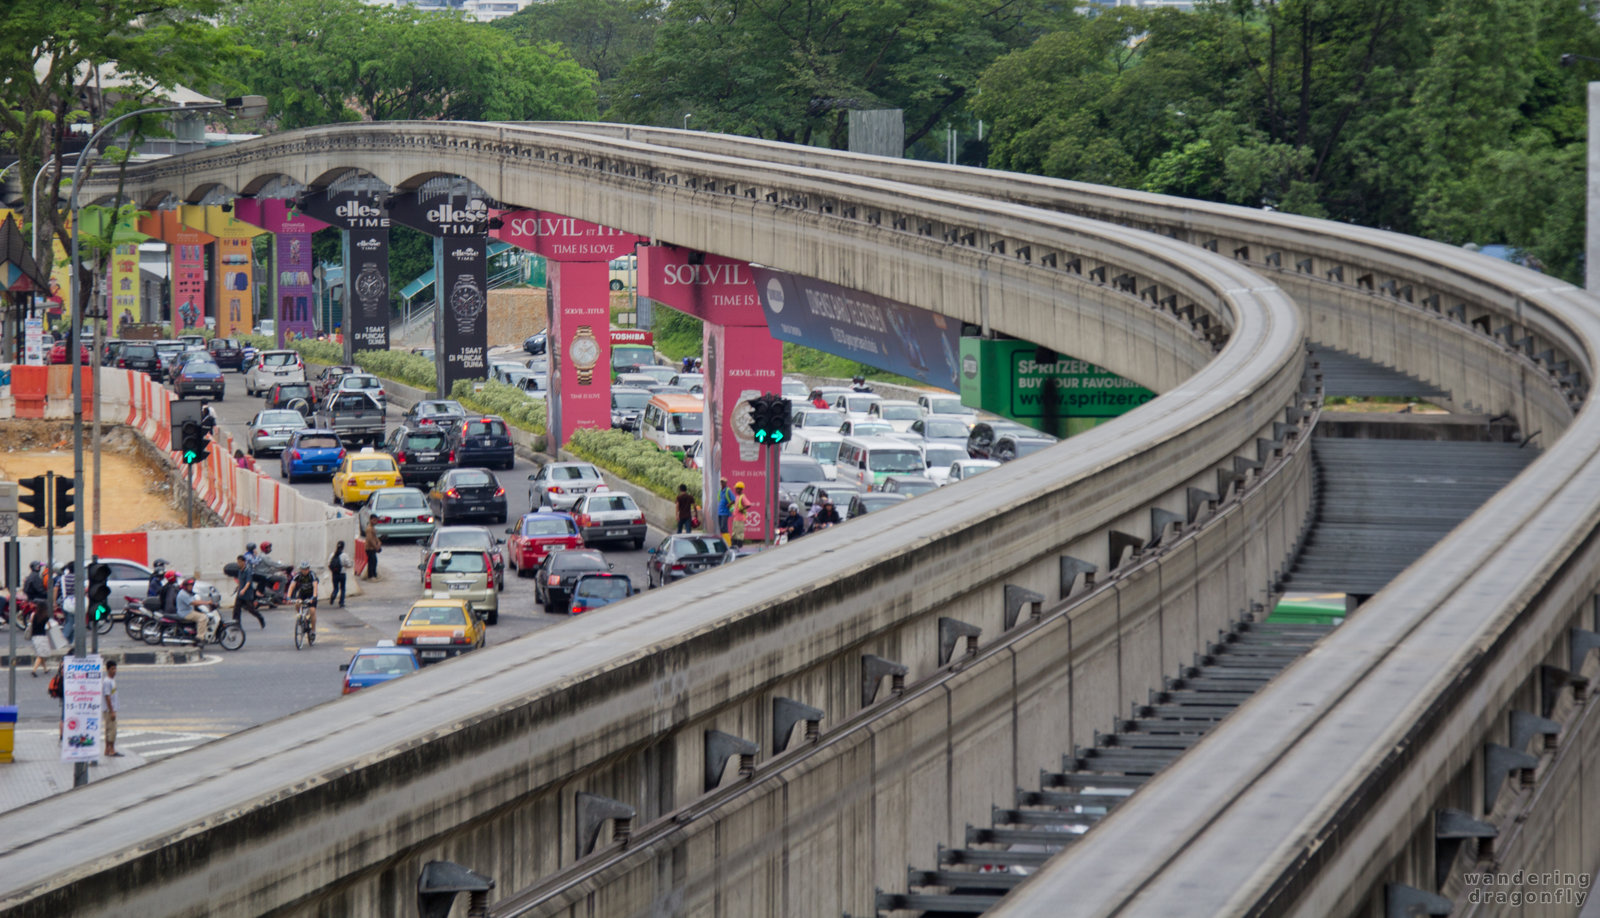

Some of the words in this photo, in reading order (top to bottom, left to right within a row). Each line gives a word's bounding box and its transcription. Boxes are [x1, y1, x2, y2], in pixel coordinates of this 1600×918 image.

[335, 200, 381, 217] elles
[426, 204, 487, 223] elless
[347, 218, 391, 227] TIME
[511, 218, 583, 236] SOLVIL
[439, 224, 480, 234] TIM
[451, 248, 479, 257] ellesse
[552, 244, 577, 254] TIME
[579, 244, 588, 254] IS
[590, 244, 615, 254] LOVE
[664, 264, 748, 285] SOLVIL
[712, 295, 742, 306] TIME
[744, 295, 754, 306] IS
[457, 354, 483, 362] PUNCAK
[1018, 360, 1089, 374] SPRITZER
[1018, 378, 1043, 388] BUY
[1047, 378, 1079, 388] OUR
